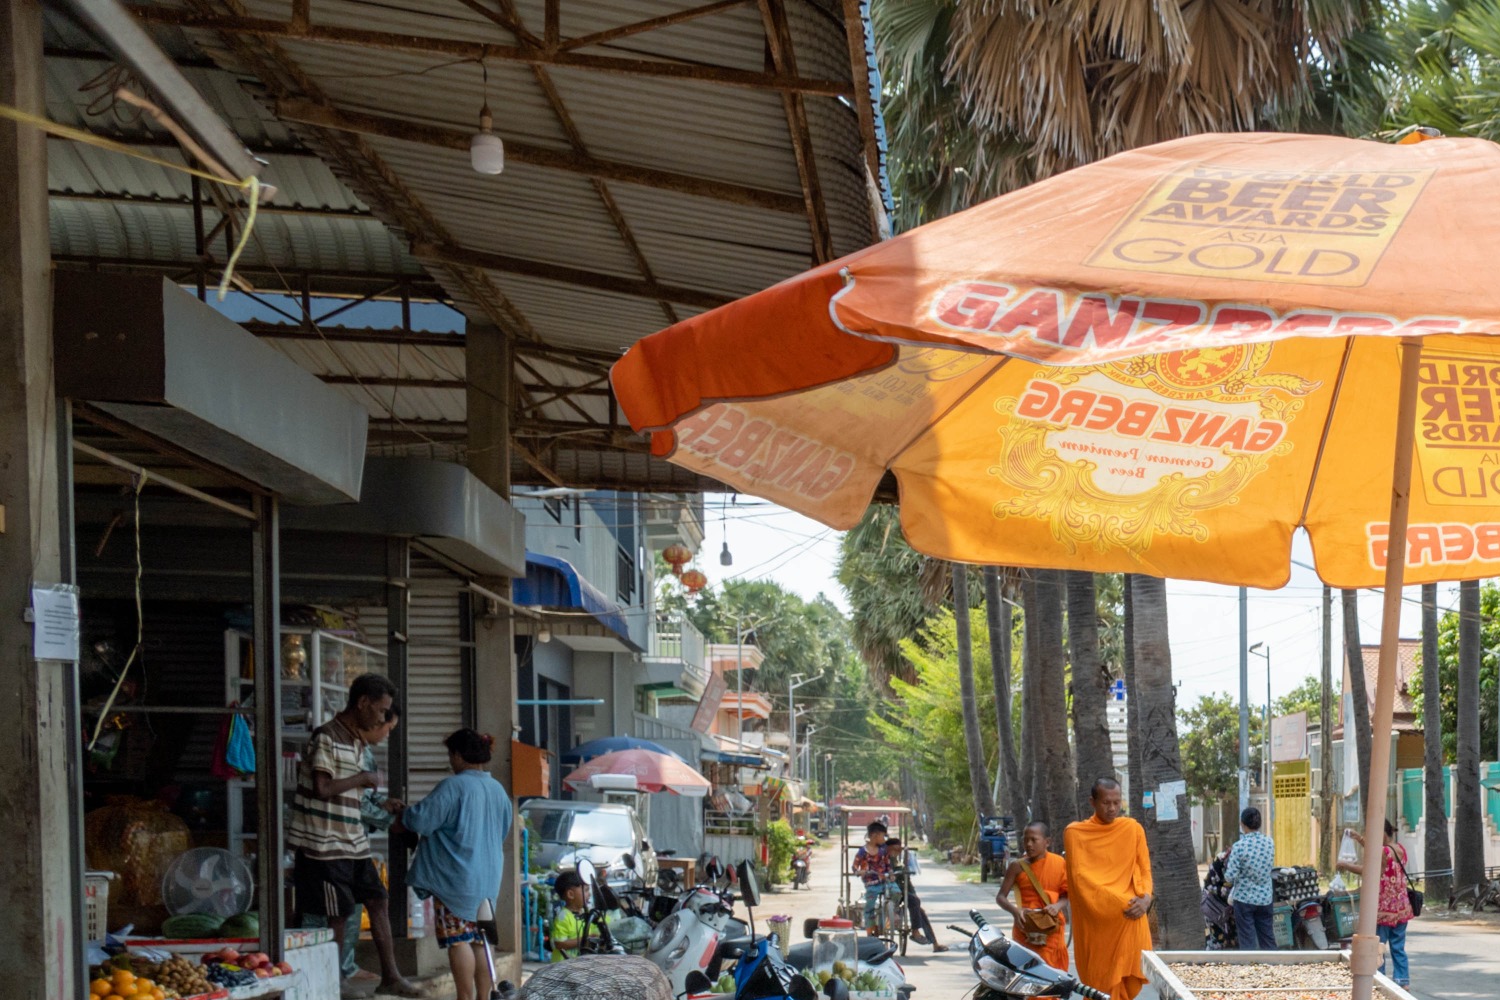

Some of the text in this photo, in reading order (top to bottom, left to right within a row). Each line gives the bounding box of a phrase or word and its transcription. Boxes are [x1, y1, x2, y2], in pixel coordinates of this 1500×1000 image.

[1193, 168, 1416, 188] WORLD
[1166, 178, 1398, 215] BEER
[1149, 202, 1391, 231] AWARDS
[1212, 230, 1287, 246] ASIA
[1112, 237, 1361, 277] GOLD
